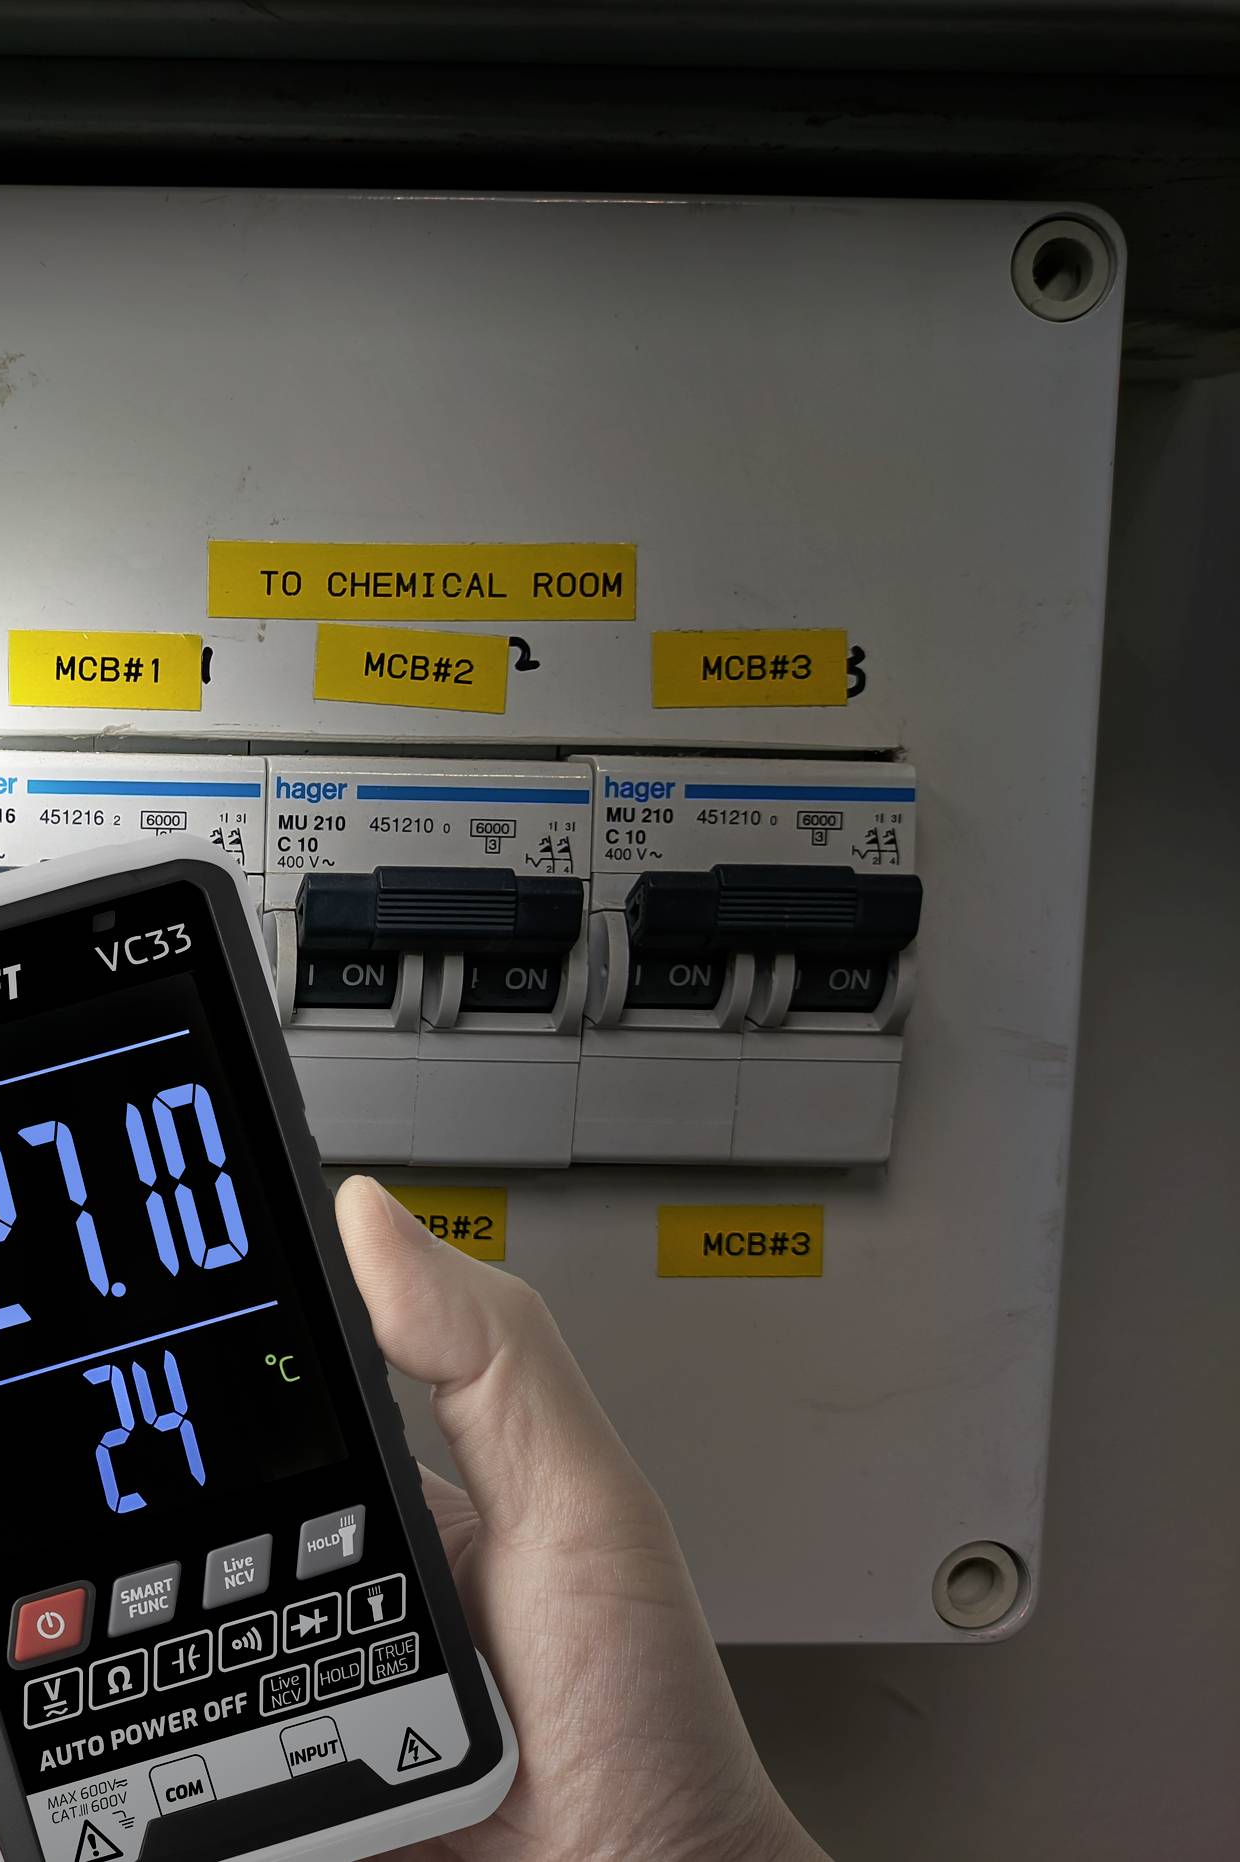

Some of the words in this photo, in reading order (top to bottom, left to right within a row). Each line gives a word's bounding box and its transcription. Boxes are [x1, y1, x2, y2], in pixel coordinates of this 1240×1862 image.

[260, 569, 302, 597] TO
[327, 571, 507, 599] CHEMICAL
[533, 572, 623, 598] ROOM
[55, 655, 161, 684] MCB#1
[364, 651, 475, 685] MCB#2
[702, 654, 812, 681] MCB#3
[276, 776, 349, 804] hager
[604, 776, 676, 803] hager
[39, 809, 105, 826] 451216
[113, 816, 121, 827] 2
[146, 813, 181, 828] 6000
[278, 815, 308, 831] MU
[314, 815, 346, 832] 210
[369, 817, 434, 834] 451210
[606, 807, 636, 823] MU
[641, 808, 674, 824] 210
[697, 810, 761, 826] 451210
[802, 814, 837, 827] 6000
[475, 822, 510, 835] 6000
[605, 829, 619, 845] C
[625, 830, 646, 845] 10
[815, 831, 824, 843] 3
[277, 837, 291, 852] C
[298, 837, 318, 852] 10
[488, 839, 497, 851] 3
[605, 848, 632, 861] 400
[277, 856, 304, 869] 400
[94, 923, 192, 972] VC33
[342, 963, 385, 986] ON
[505, 967, 548, 990] ON
[669, 964, 710, 987] ON
[829, 969, 870, 990] ON
[413, 1214, 493, 1240] B#2
[702, 1231, 811, 1256] MCB#3
[83, 1350, 206, 1514] 24
[307, 1533, 341, 1553] HOLD
[223, 1554, 254, 1573] Live
[224, 1569, 256, 1590] NCV
[120, 1577, 173, 1605] SMART
[128, 1596, 169, 1619] FUNC
[374, 1638, 415, 1660] TRUE
[319, 1663, 360, 1687] HOLD
[376, 1656, 410, 1679] RMS
[269, 1673, 300, 1692] Live
[271, 1688, 301, 1709] NCV
[39, 1735, 105, 1772] AUTO
[112, 1707, 199, 1752] POWER
[205, 1692, 249, 1723] OFF
[289, 1739, 339, 1766] INPUT
[47, 1790, 77, 1810] MAX
[91, 1791, 128, 1813] 600V
[165, 1779, 204, 1803] COM
